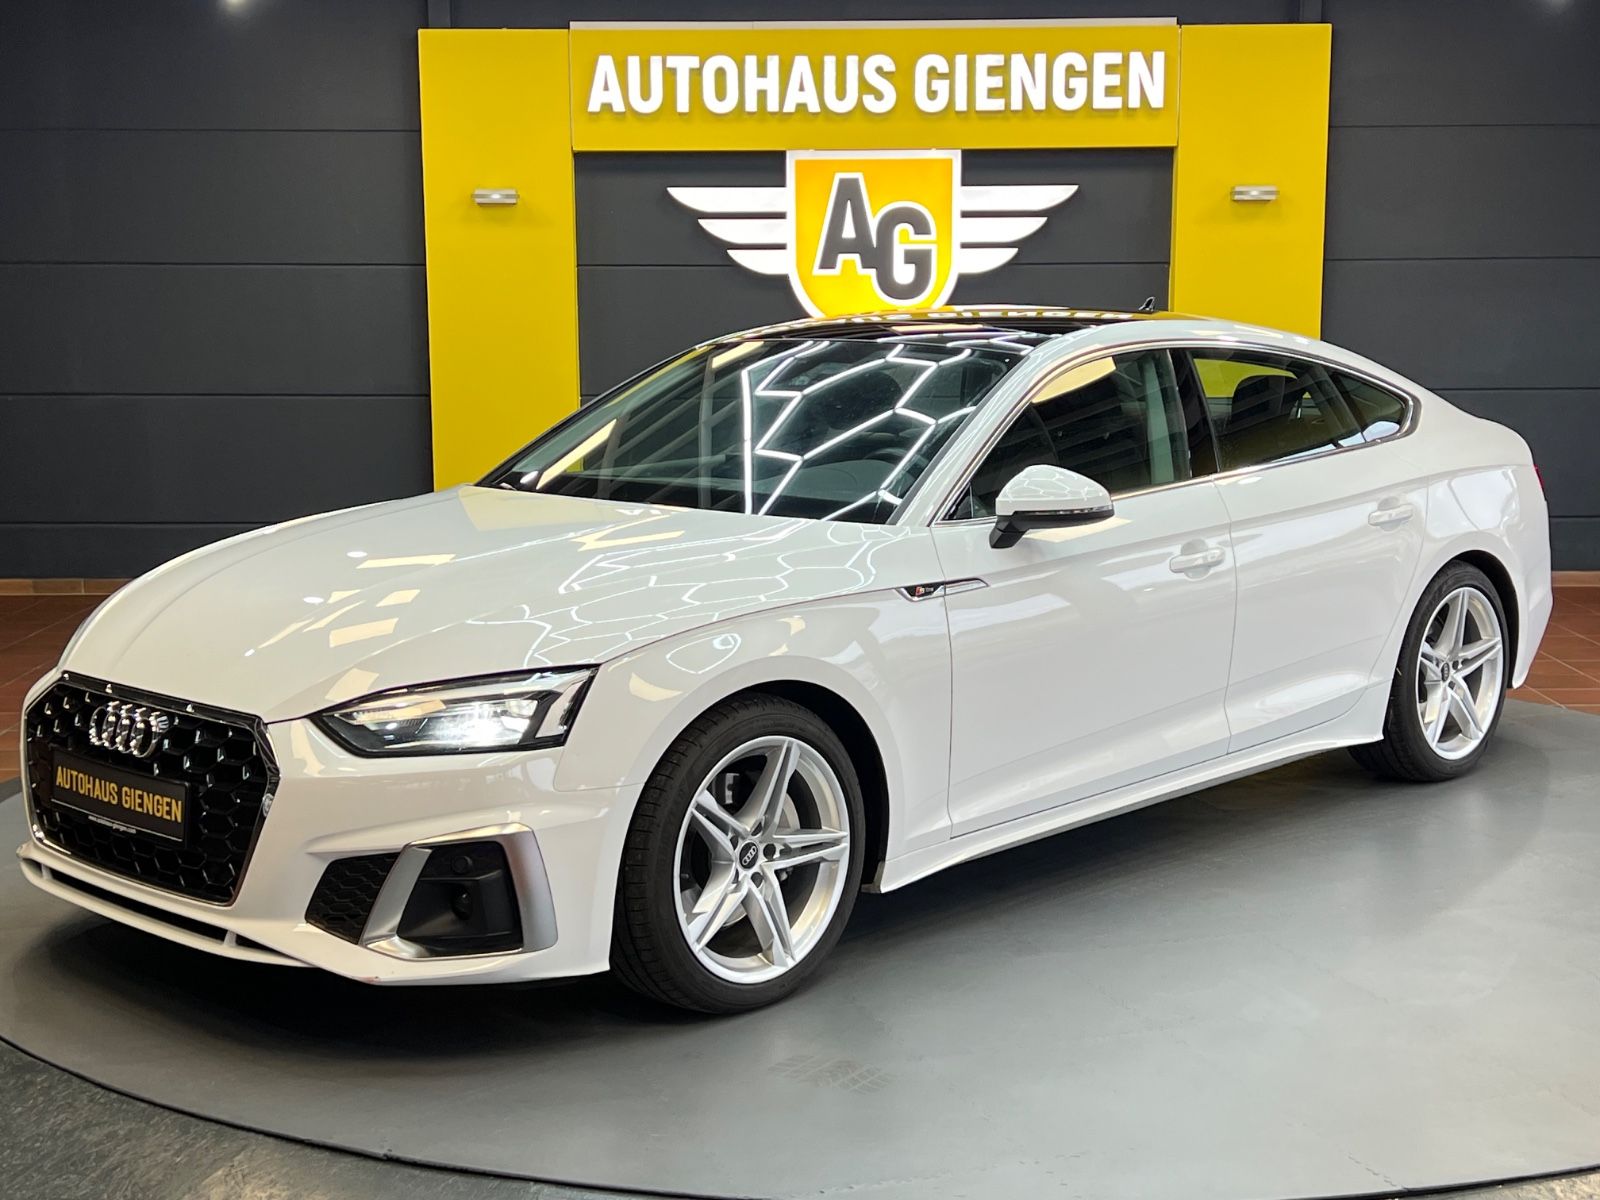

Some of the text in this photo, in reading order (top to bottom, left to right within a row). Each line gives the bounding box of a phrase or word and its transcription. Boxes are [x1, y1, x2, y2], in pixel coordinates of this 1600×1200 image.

[587, 51, 1165, 114] AUTOHAUS GIENGEN
[815, 173, 937, 305] AG
[56, 766, 182, 823] AUTOHAUS GIENGEN
